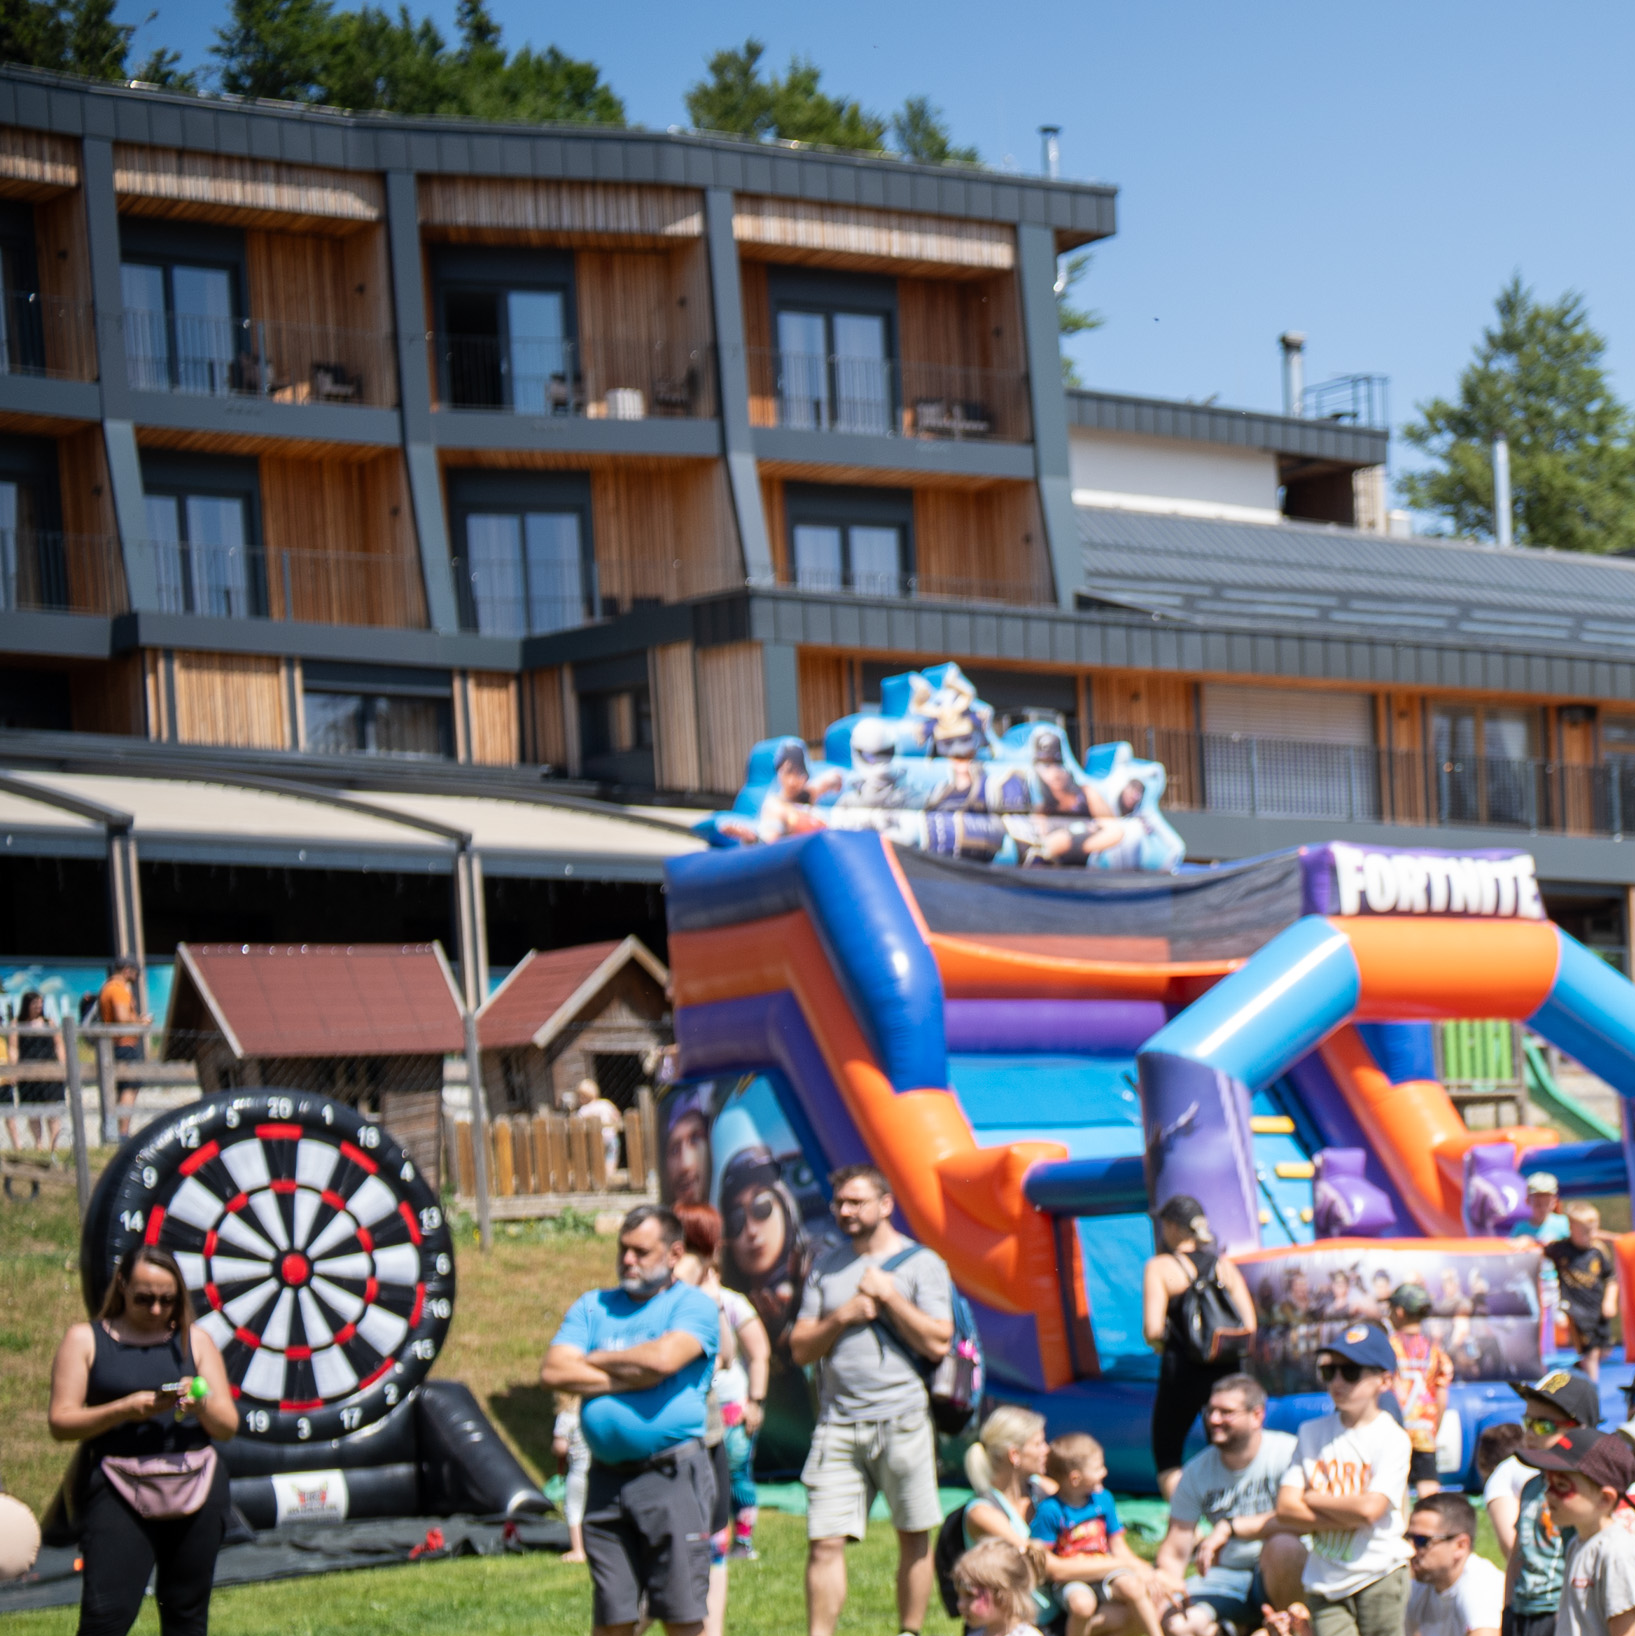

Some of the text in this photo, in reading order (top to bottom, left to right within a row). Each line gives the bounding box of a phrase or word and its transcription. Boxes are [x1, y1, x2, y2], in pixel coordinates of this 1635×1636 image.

[1331, 845, 1545, 919] FORTNITE
[226, 1107, 240, 1128] 5
[267, 1096, 293, 1119] 20
[321, 1104, 333, 1125] 1
[142, 1166, 158, 1188] 9
[401, 1162, 415, 1182] 4
[120, 1210, 144, 1233] 14
[435, 1253, 450, 1275] 6
[384, 1383, 399, 1404] 2
[246, 1409, 270, 1432] 19
[297, 1417, 311, 1440] 3
[340, 1407, 362, 1429] 17
